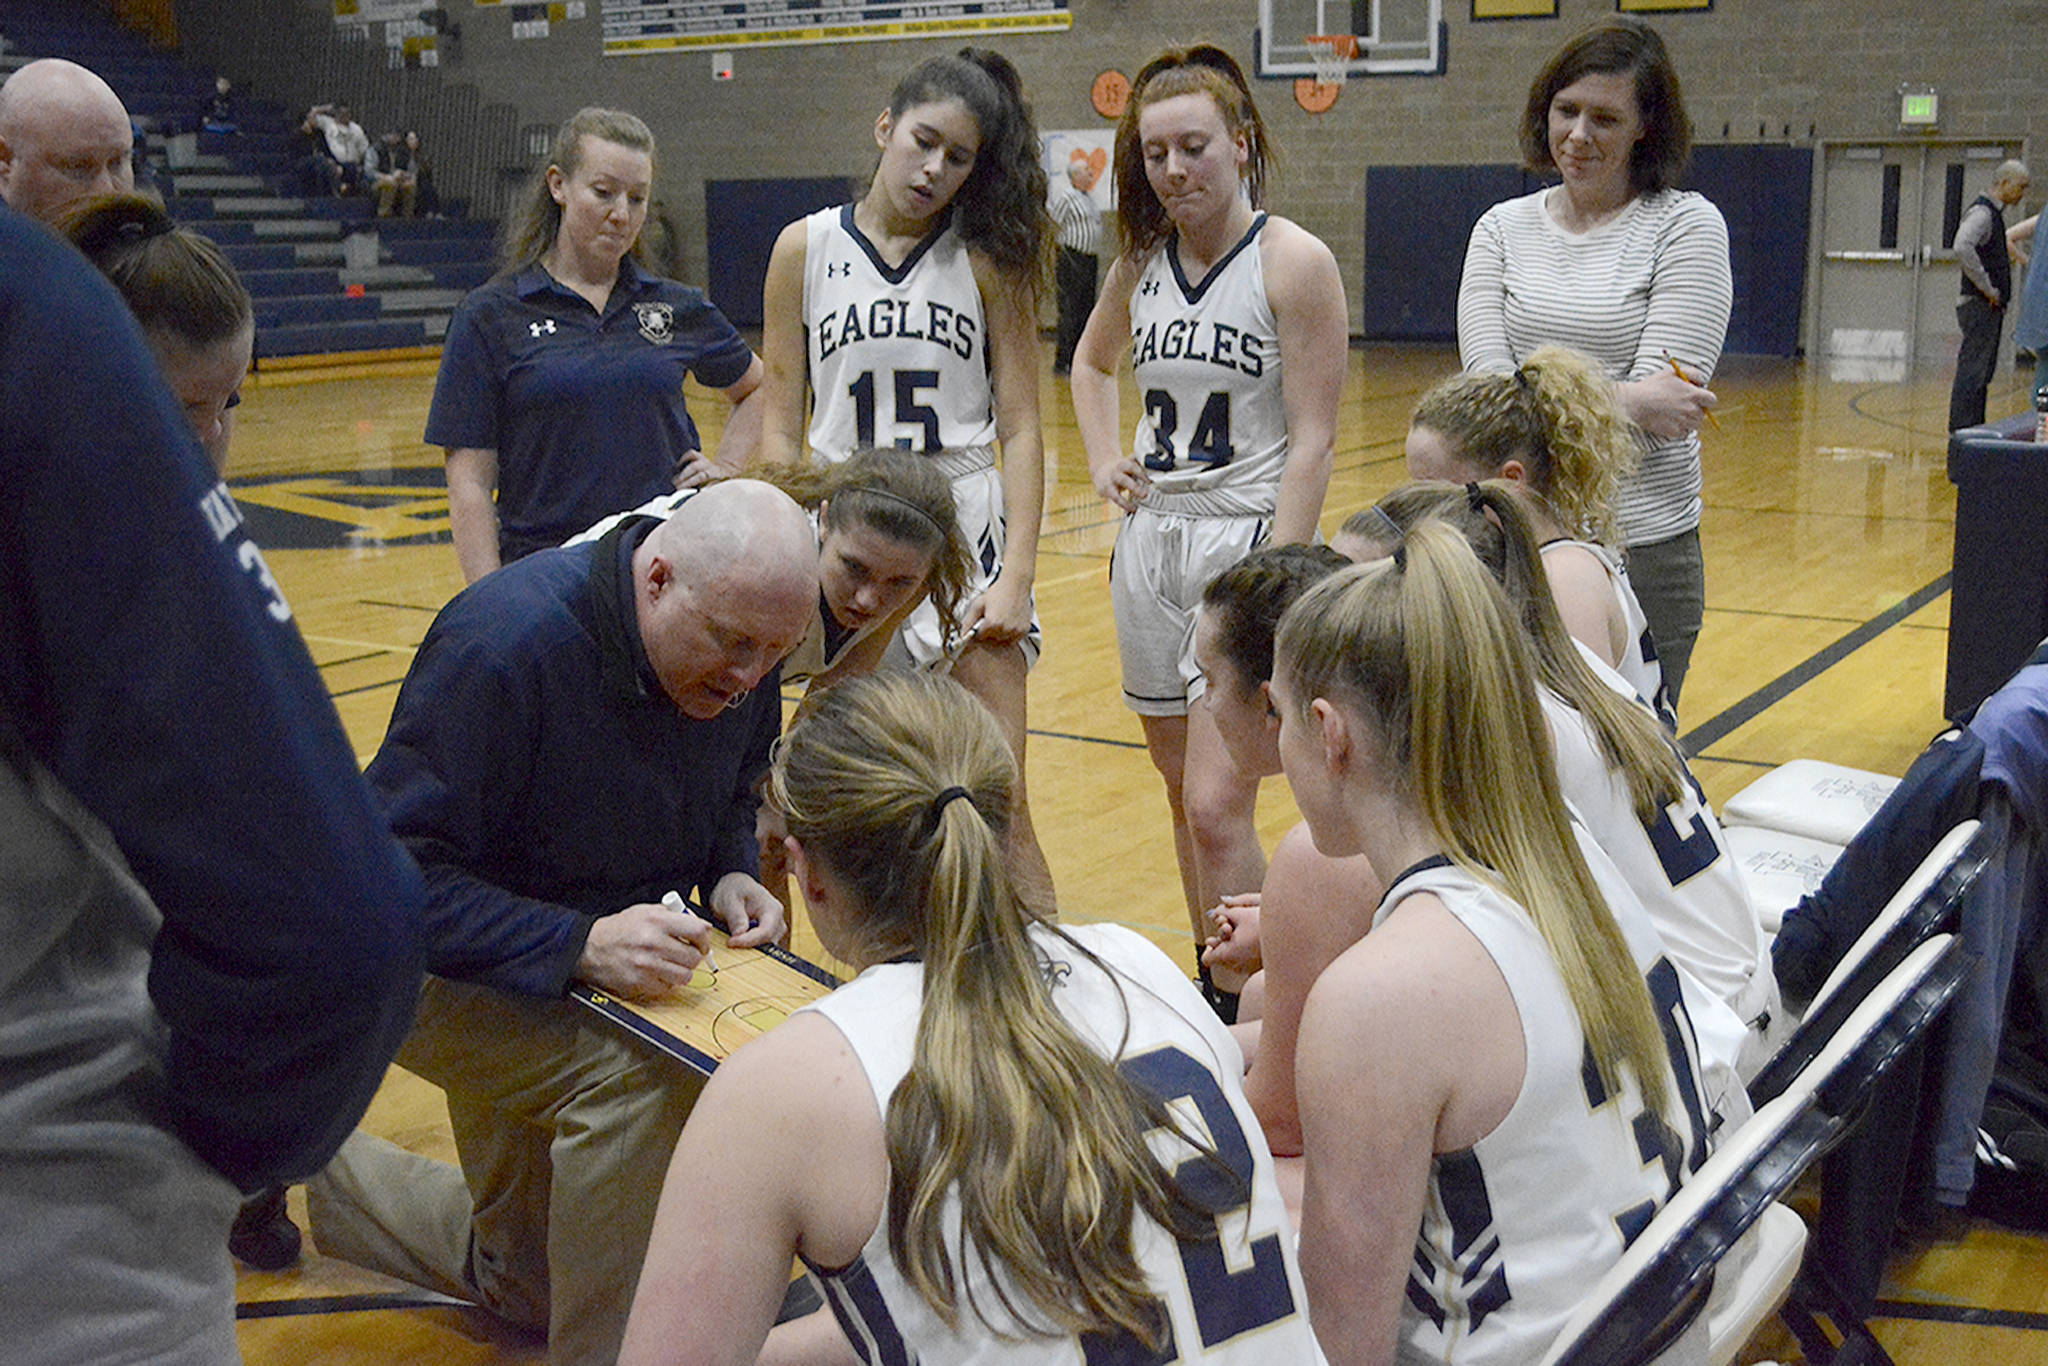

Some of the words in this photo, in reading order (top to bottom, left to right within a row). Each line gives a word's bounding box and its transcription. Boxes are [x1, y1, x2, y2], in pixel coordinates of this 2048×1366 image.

[819, 298, 976, 362] EAGLES
[848, 369, 944, 456] 15
[1144, 388, 1236, 472] 34
[1078, 1043, 1298, 1364] 2
